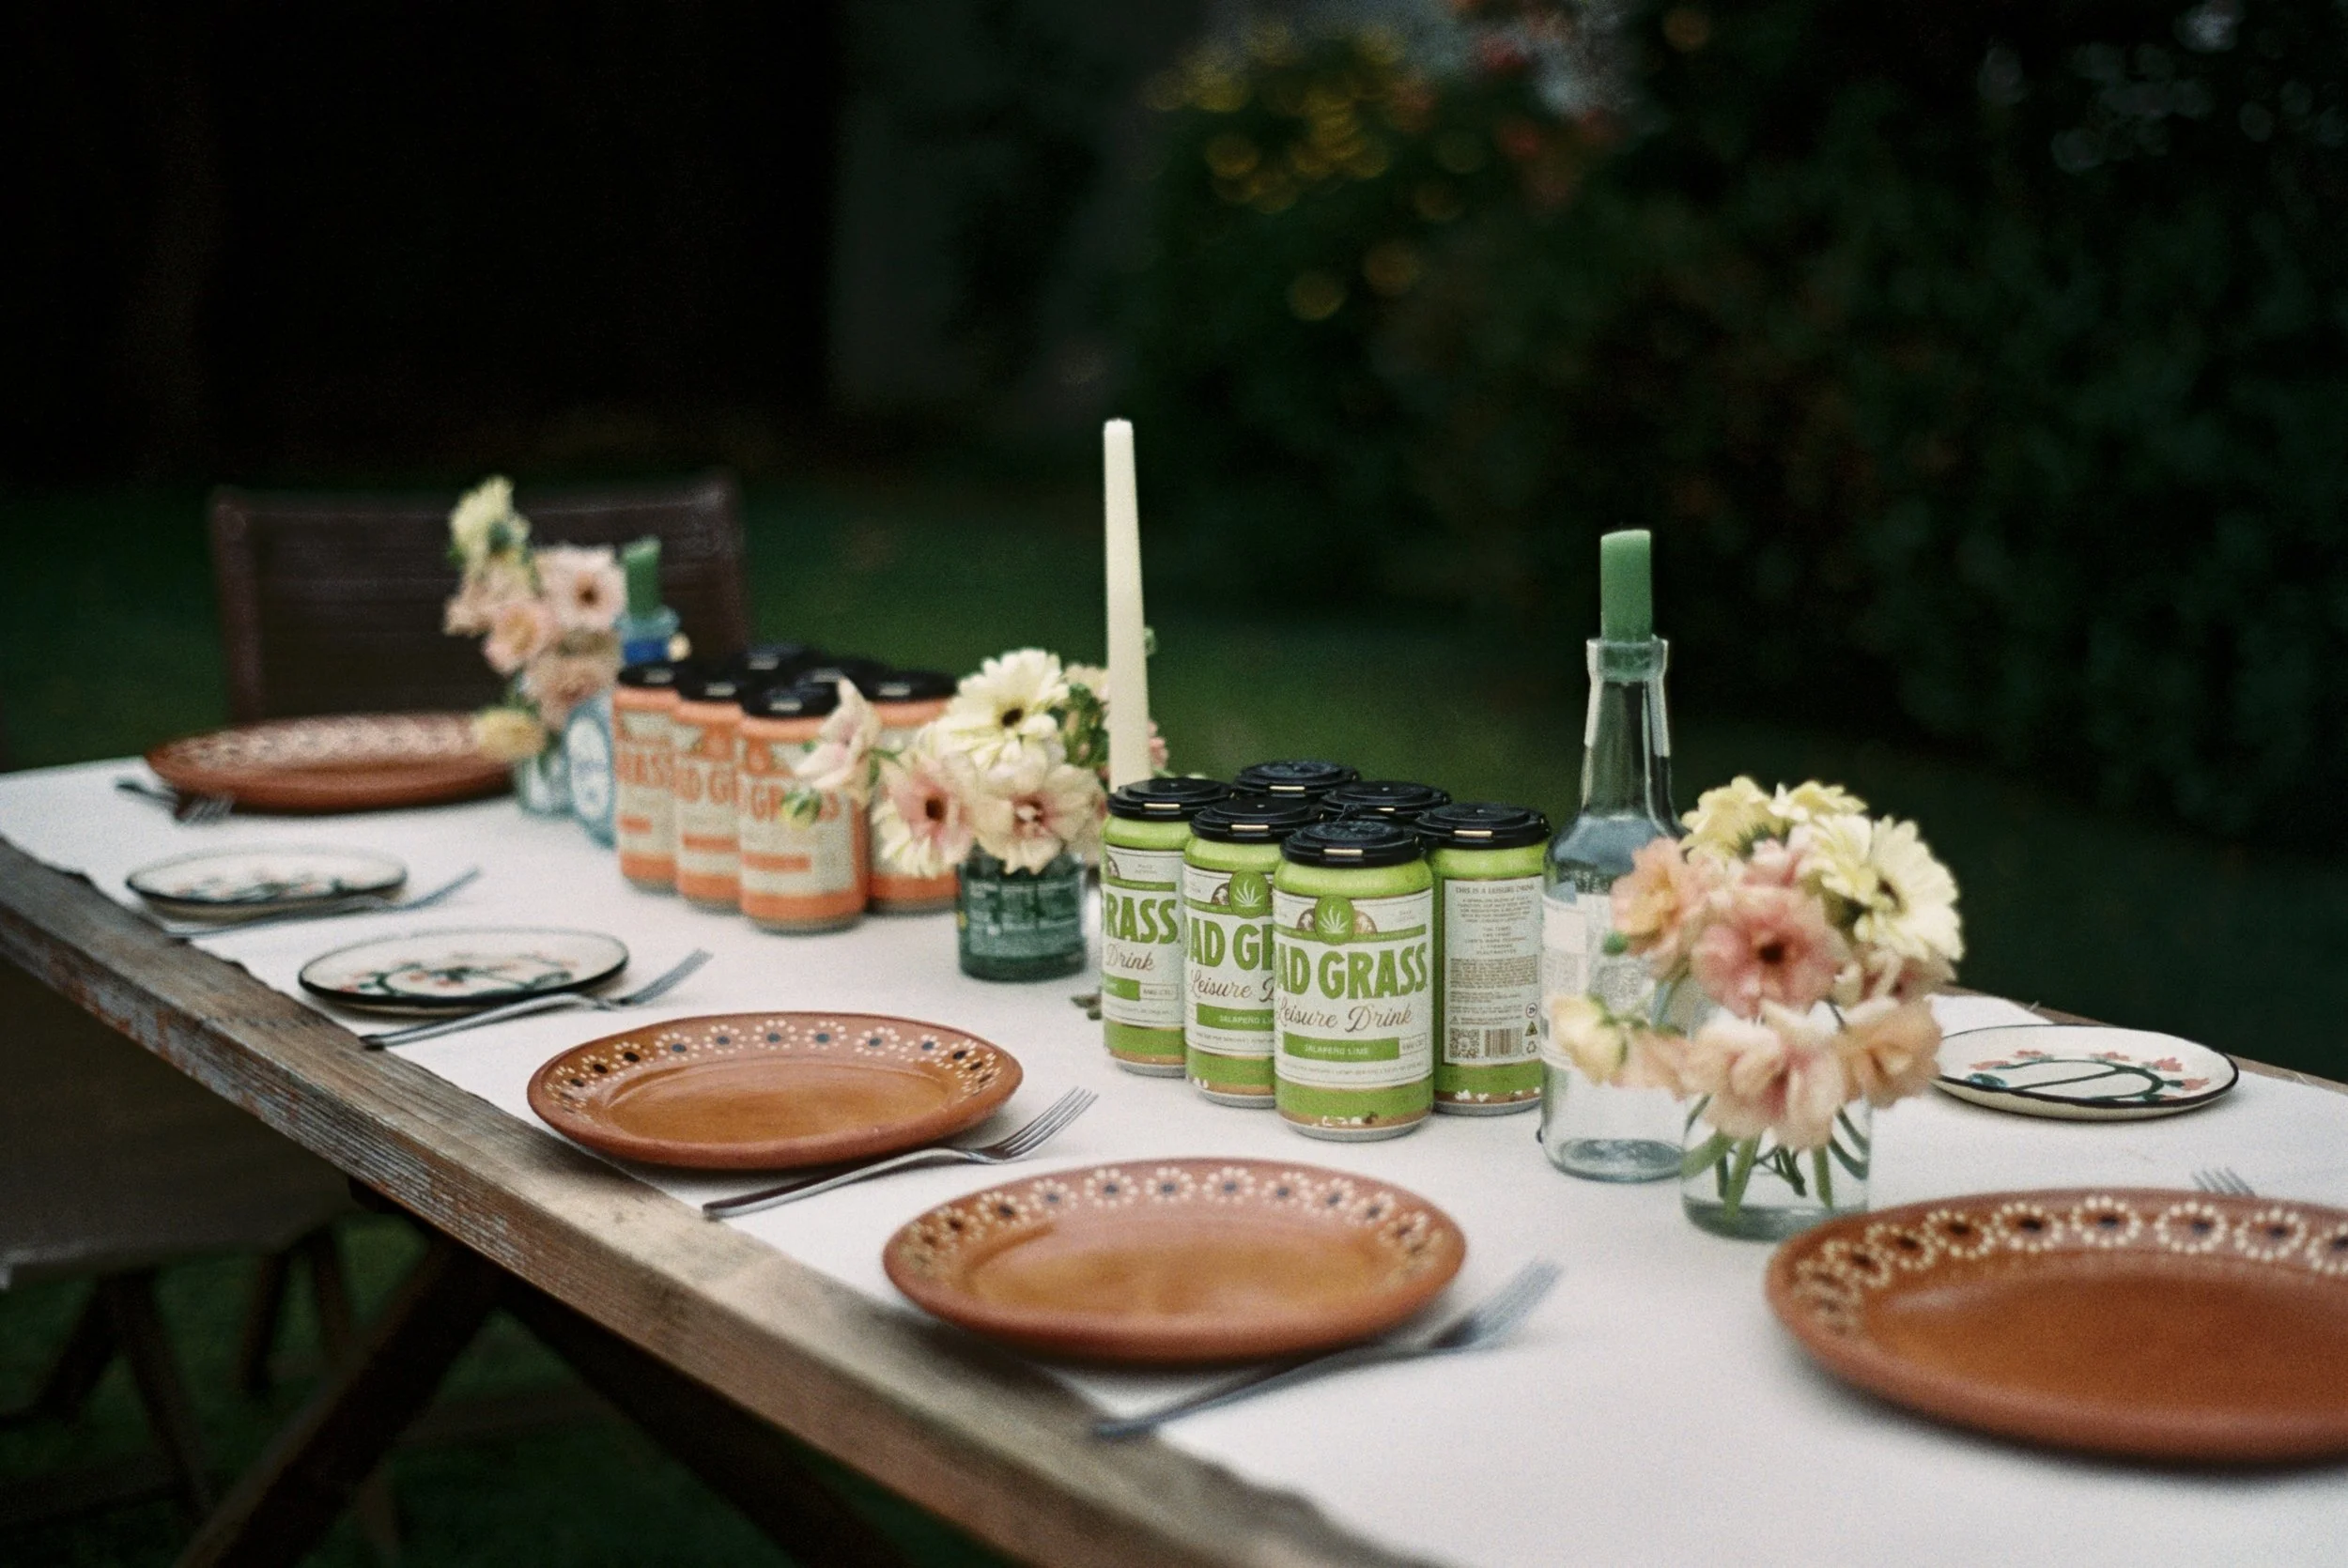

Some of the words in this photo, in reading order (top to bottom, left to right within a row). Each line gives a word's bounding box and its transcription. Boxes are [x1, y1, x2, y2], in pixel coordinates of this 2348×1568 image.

[1103, 892, 1178, 945] RASS
[1105, 943, 1155, 971] Drink
[1182, 912, 1226, 968] AD
[1190, 969, 1252, 999] Leisure
[1274, 943, 1311, 995] AD
[1318, 943, 1427, 1000] GRASS
[1277, 996, 1337, 1029] Leisure
[1344, 1003, 1412, 1033] Drink
[1347, 1046, 1368, 1056] LIME
